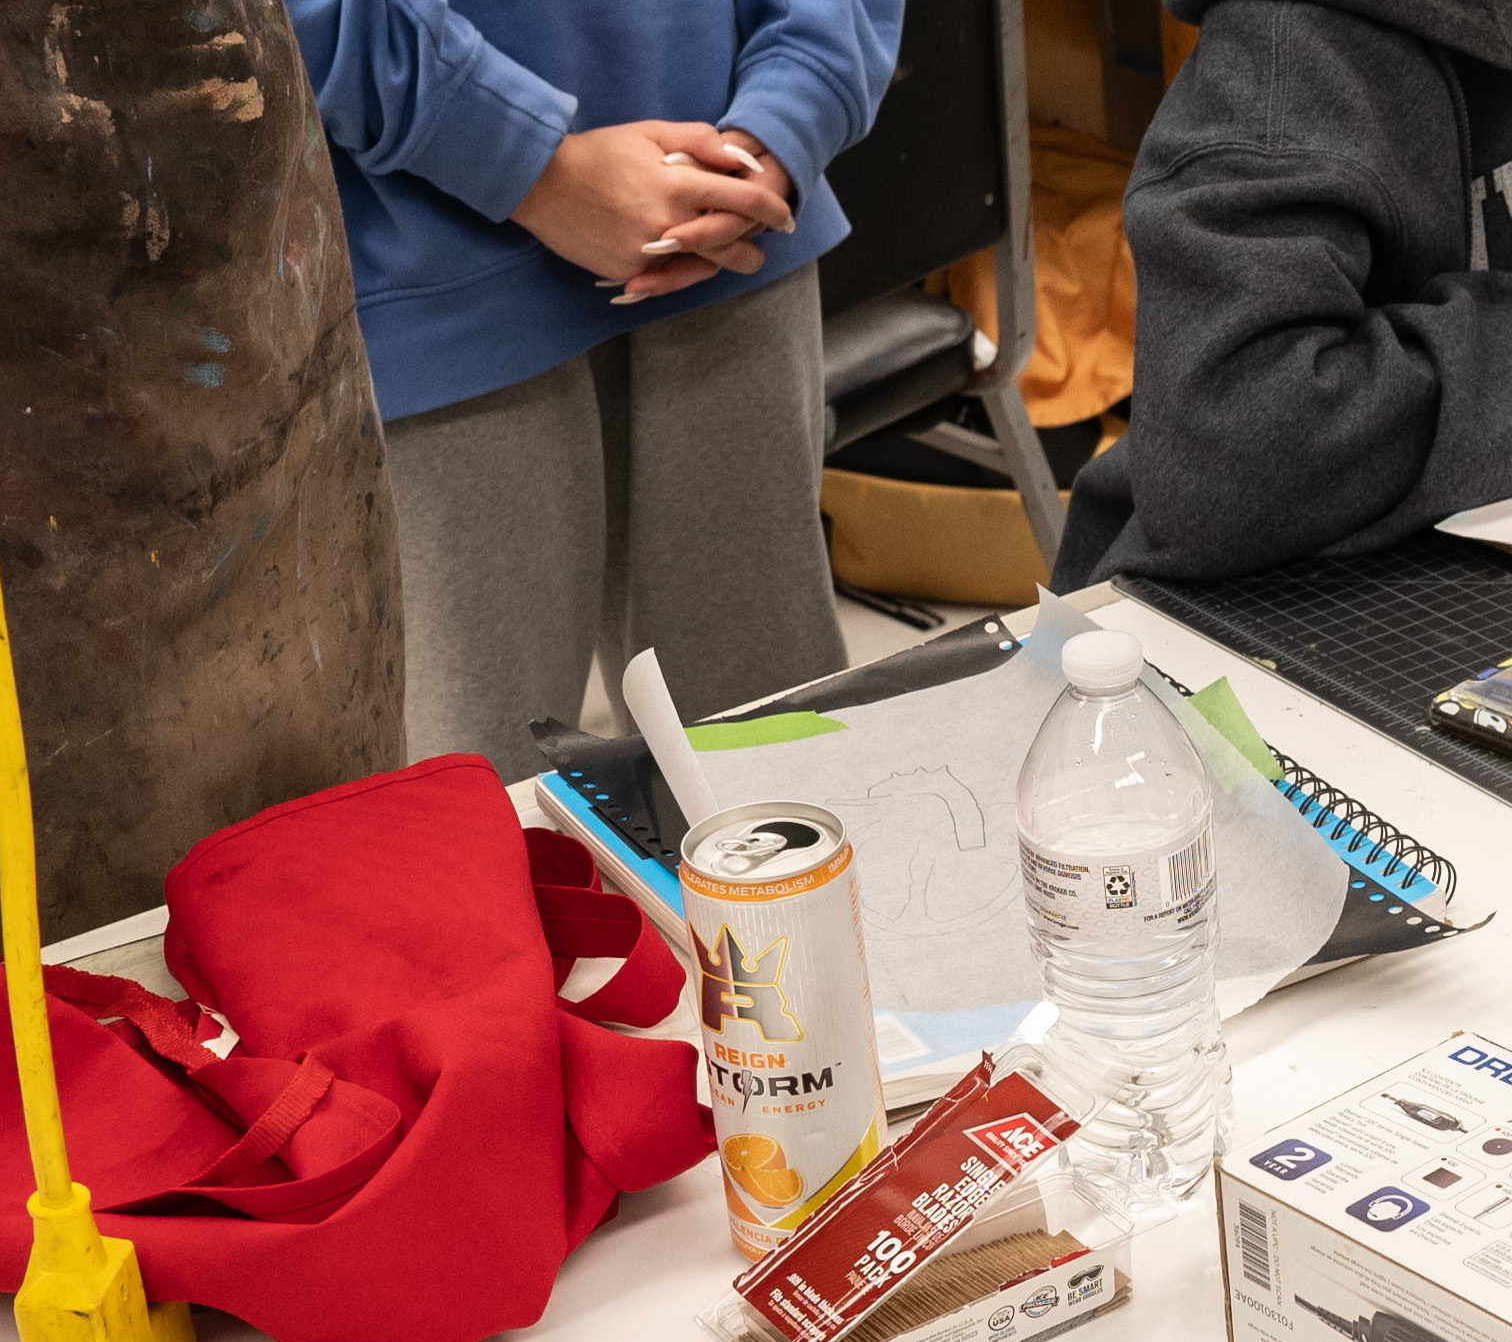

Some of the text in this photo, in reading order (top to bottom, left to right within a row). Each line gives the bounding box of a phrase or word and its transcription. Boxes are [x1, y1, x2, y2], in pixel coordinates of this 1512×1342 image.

[729, 875, 815, 896] METABOLISM
[714, 1041, 785, 1068] REIGN
[762, 1098, 827, 1114] ENERGY
[1000, 1125, 1044, 1158] ACE
[1274, 1146, 1316, 1169] 2
[960, 1155, 1006, 1196] SINGLE
[1263, 1159, 1288, 1175] YEAR
[931, 1183, 975, 1221] RAZOR
[953, 1176, 990, 1208] EDGE
[912, 1192, 959, 1235] BLADES
[867, 1230, 917, 1274] 100
[854, 1254, 892, 1288] PACK
[992, 1315, 1010, 1327] USA
[1233, 1289, 1295, 1333] F0130100AE
